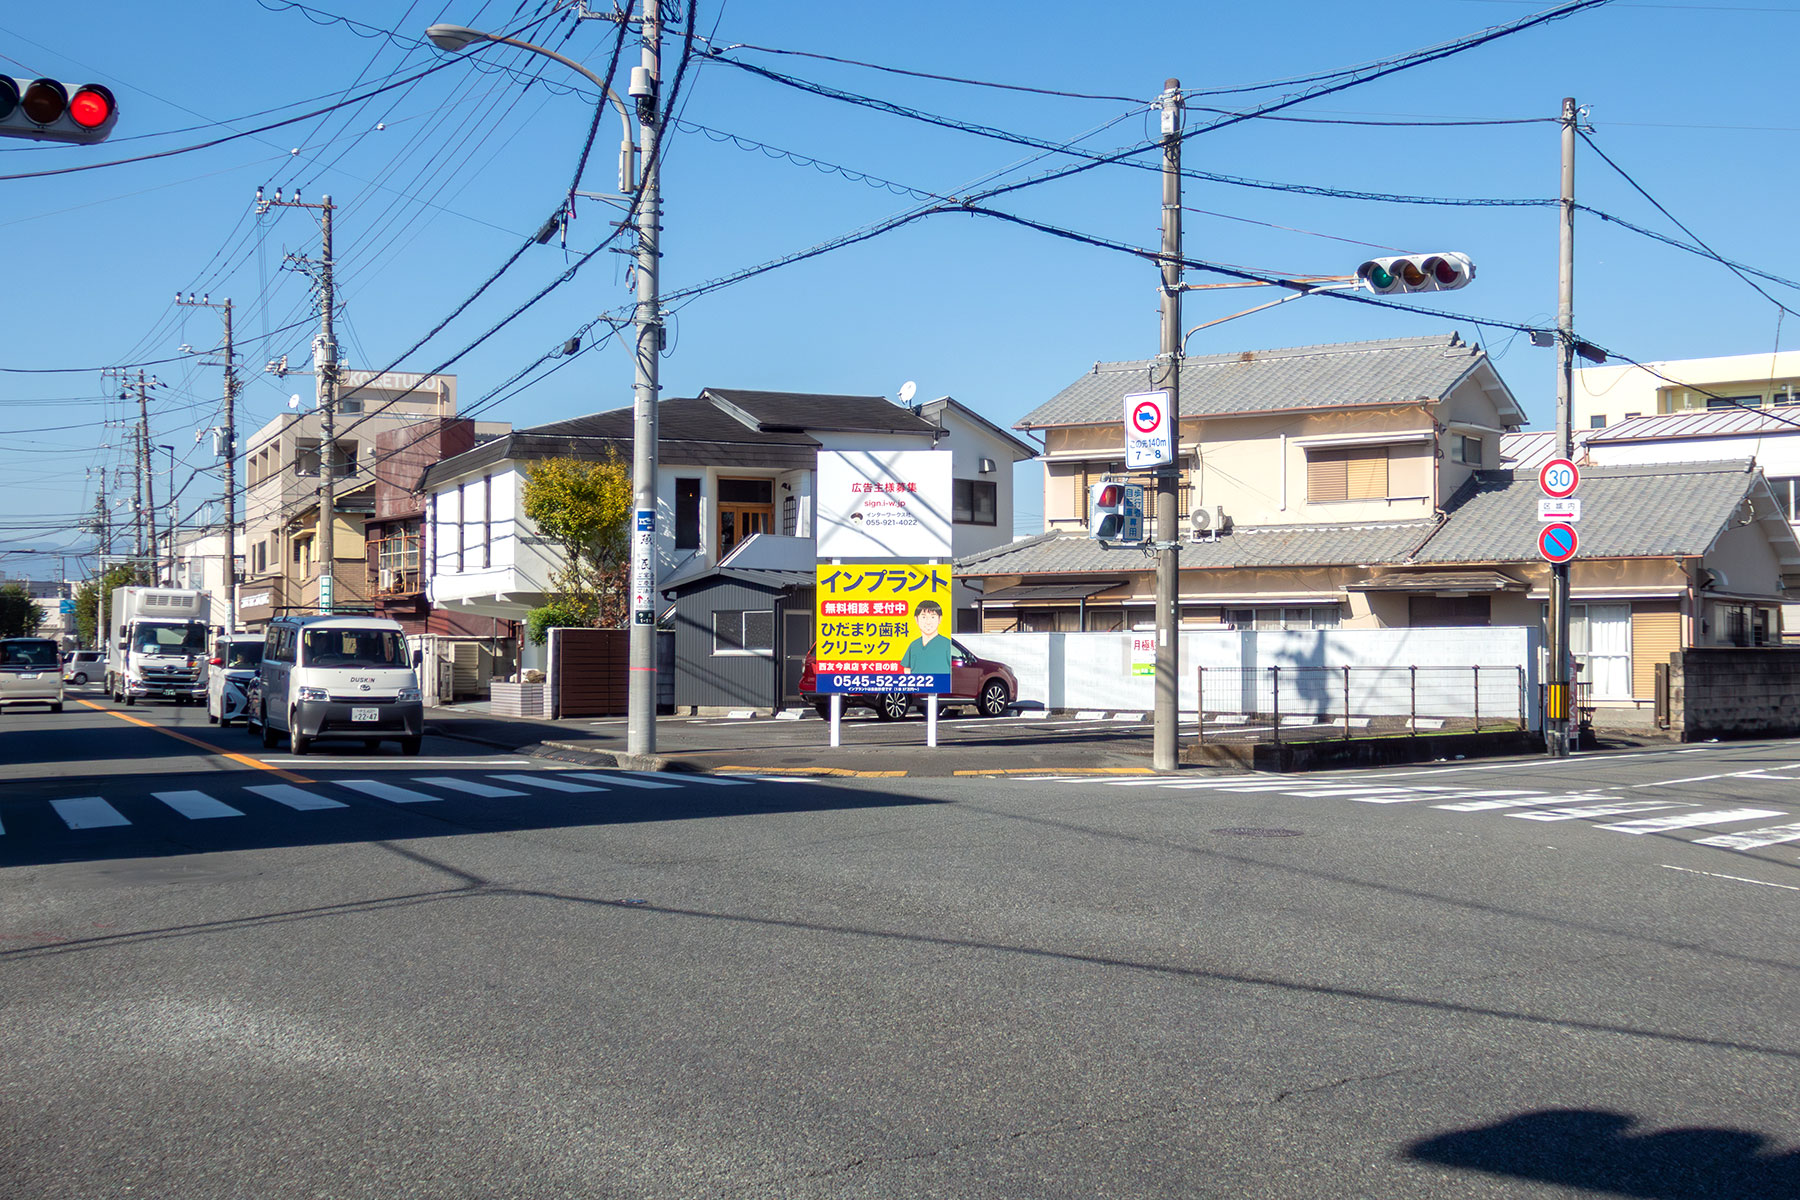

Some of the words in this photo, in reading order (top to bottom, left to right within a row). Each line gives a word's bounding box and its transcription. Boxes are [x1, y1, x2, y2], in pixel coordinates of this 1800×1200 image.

[1129, 437, 1167, 449] この先140m
[1548, 469, 1570, 487] 30
[851, 482, 918, 493] 広告主様募集
[863, 500, 906, 508] sign.i-w.jp
[1543, 502, 1576, 510] 区域内
[820, 569, 949, 593] インプラント
[825, 602, 870, 614] 無料相談
[873, 602, 906, 614] 受付中
[821, 622, 909, 637] ひだまり歯科
[821, 640, 890, 655] クリニック
[860, 662, 898, 671] すぐ目の前
[833, 675, 934, 687] 0545-52-2222
